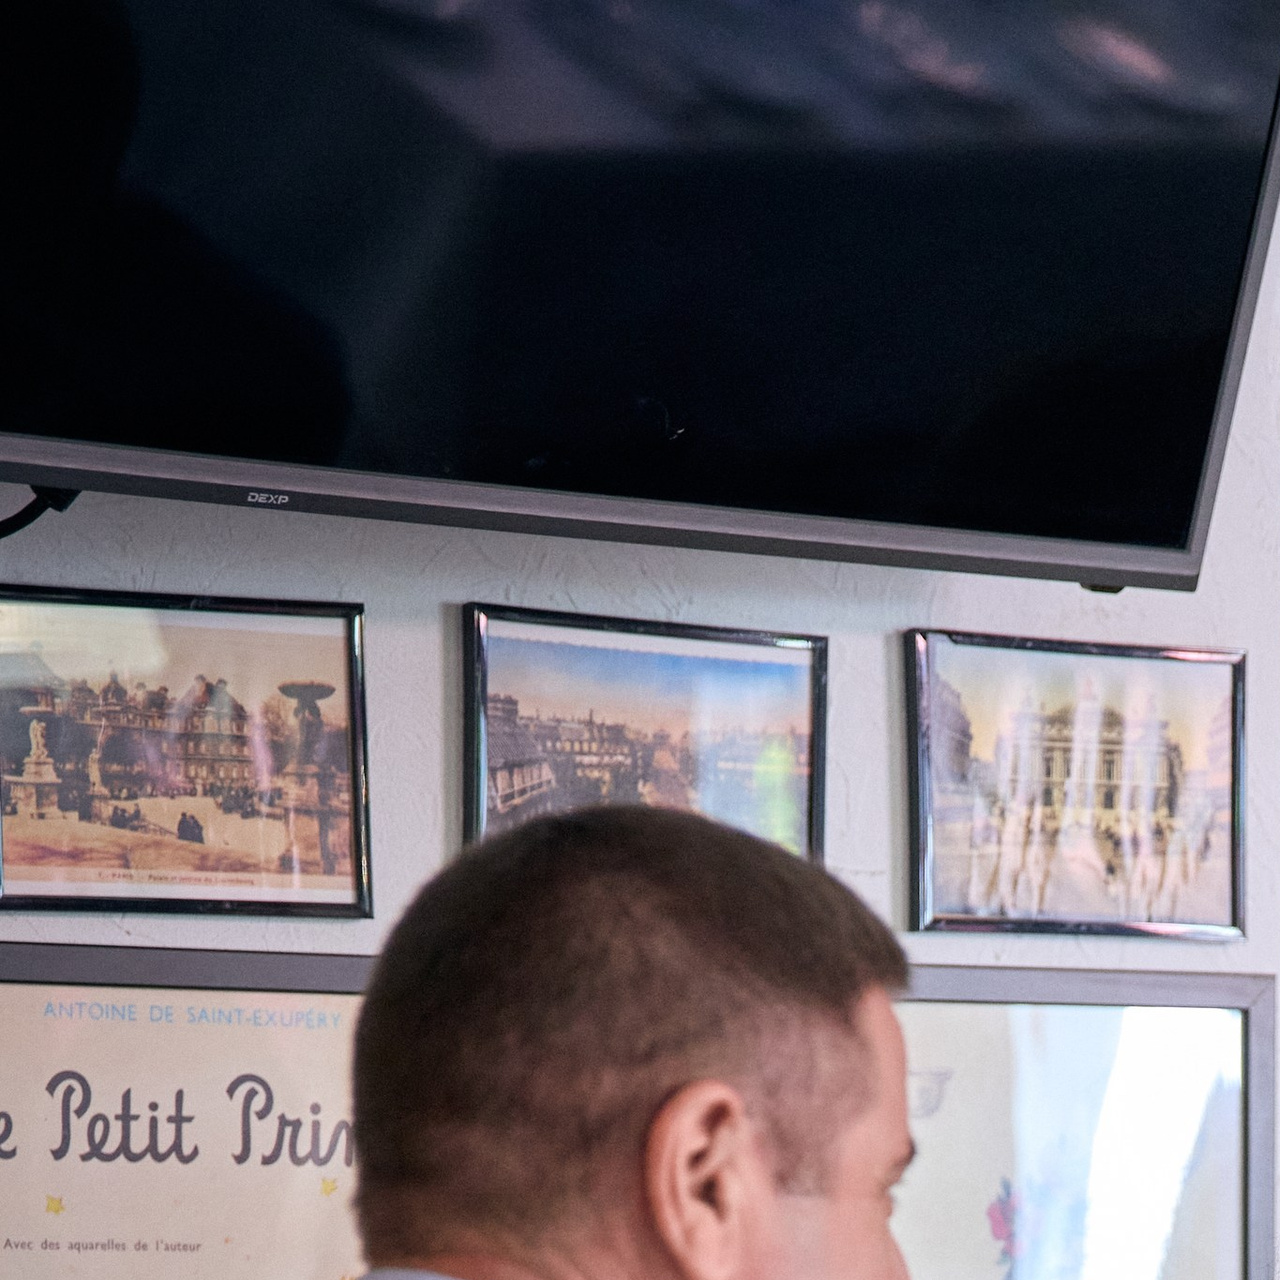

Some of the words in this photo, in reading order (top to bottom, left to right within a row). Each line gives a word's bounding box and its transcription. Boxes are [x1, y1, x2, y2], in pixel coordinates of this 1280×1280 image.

[247, 492, 289, 504] DEXP
[44, 1001, 137, 1022] ANTOINE
[150, 1005, 174, 1023] DE
[187, 1006, 341, 1030] SAINT-EXUPÉRY
[45, 1070, 200, 1164] Petit
[3, 1238, 33, 1250] Avec
[41, 1239, 60, 1250] des
[68, 1239, 126, 1253] aquarelles
[134, 1240, 148, 1252] de
[156, 1240, 201, 1252] l'auteur
